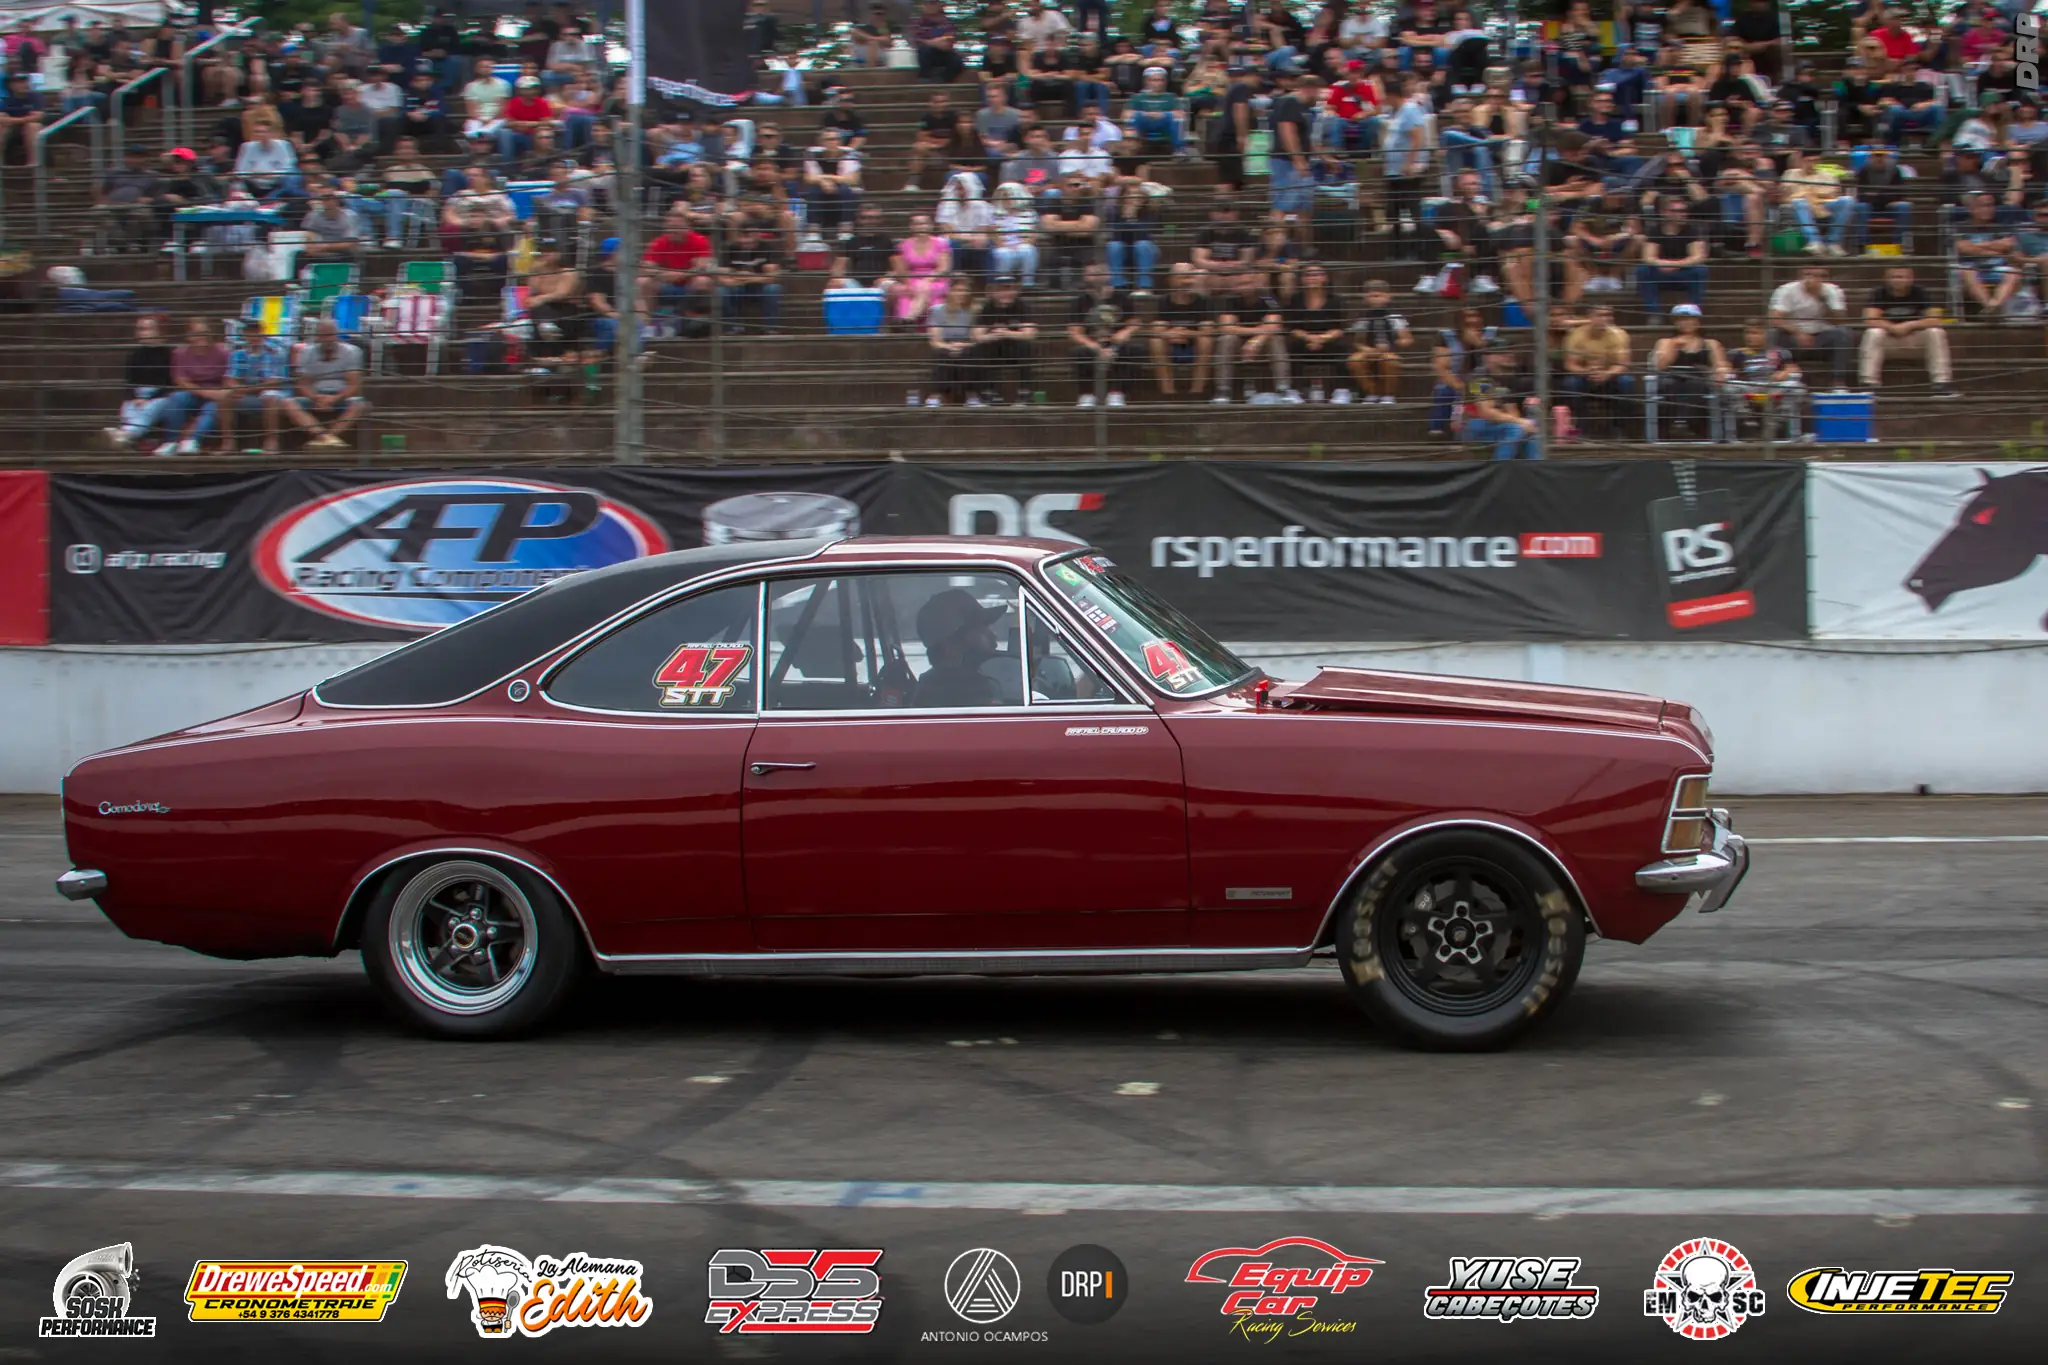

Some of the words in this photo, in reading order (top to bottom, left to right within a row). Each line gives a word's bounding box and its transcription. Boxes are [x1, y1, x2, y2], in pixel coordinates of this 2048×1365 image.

[1662, 521, 1735, 571] RS
[296, 566, 399, 591] Racing
[659, 649, 748, 687] 47
[663, 687, 731, 704] STT
